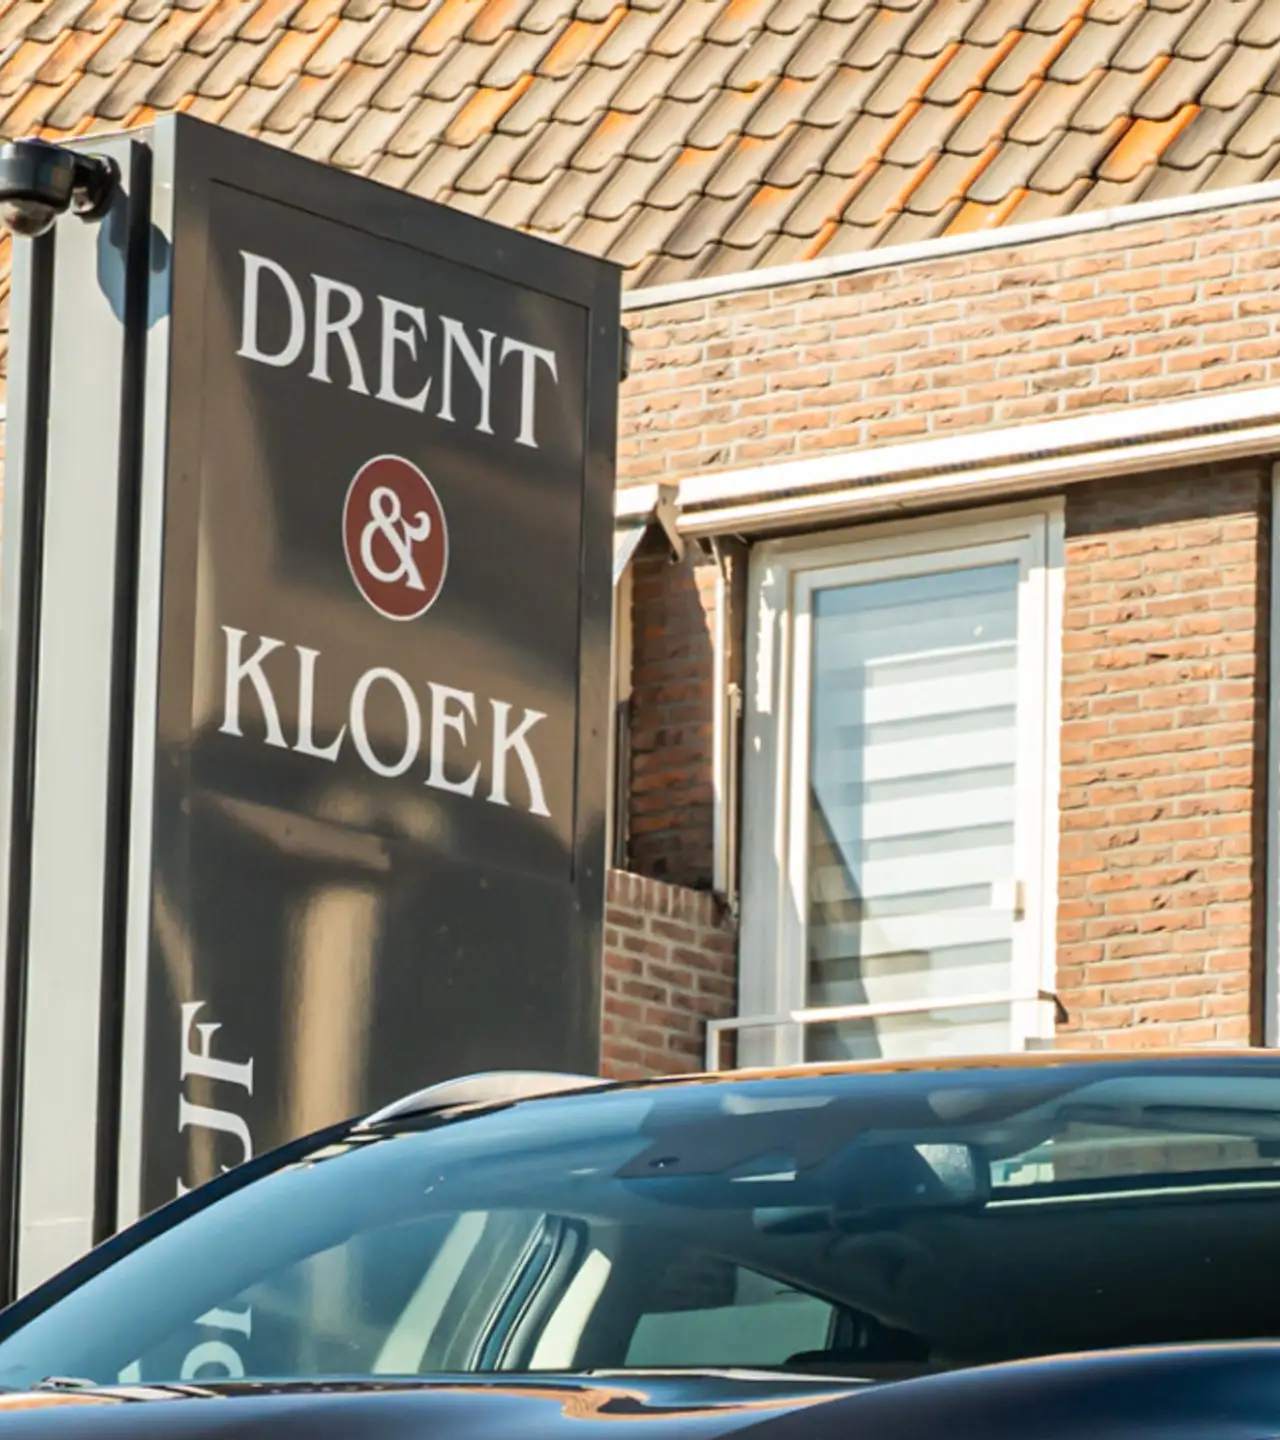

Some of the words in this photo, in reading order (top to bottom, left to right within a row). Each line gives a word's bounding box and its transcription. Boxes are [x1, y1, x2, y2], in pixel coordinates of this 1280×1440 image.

[237, 250, 559, 449] DRENT
[360, 486, 431, 591] &
[219, 625, 551, 817] KLOEK
